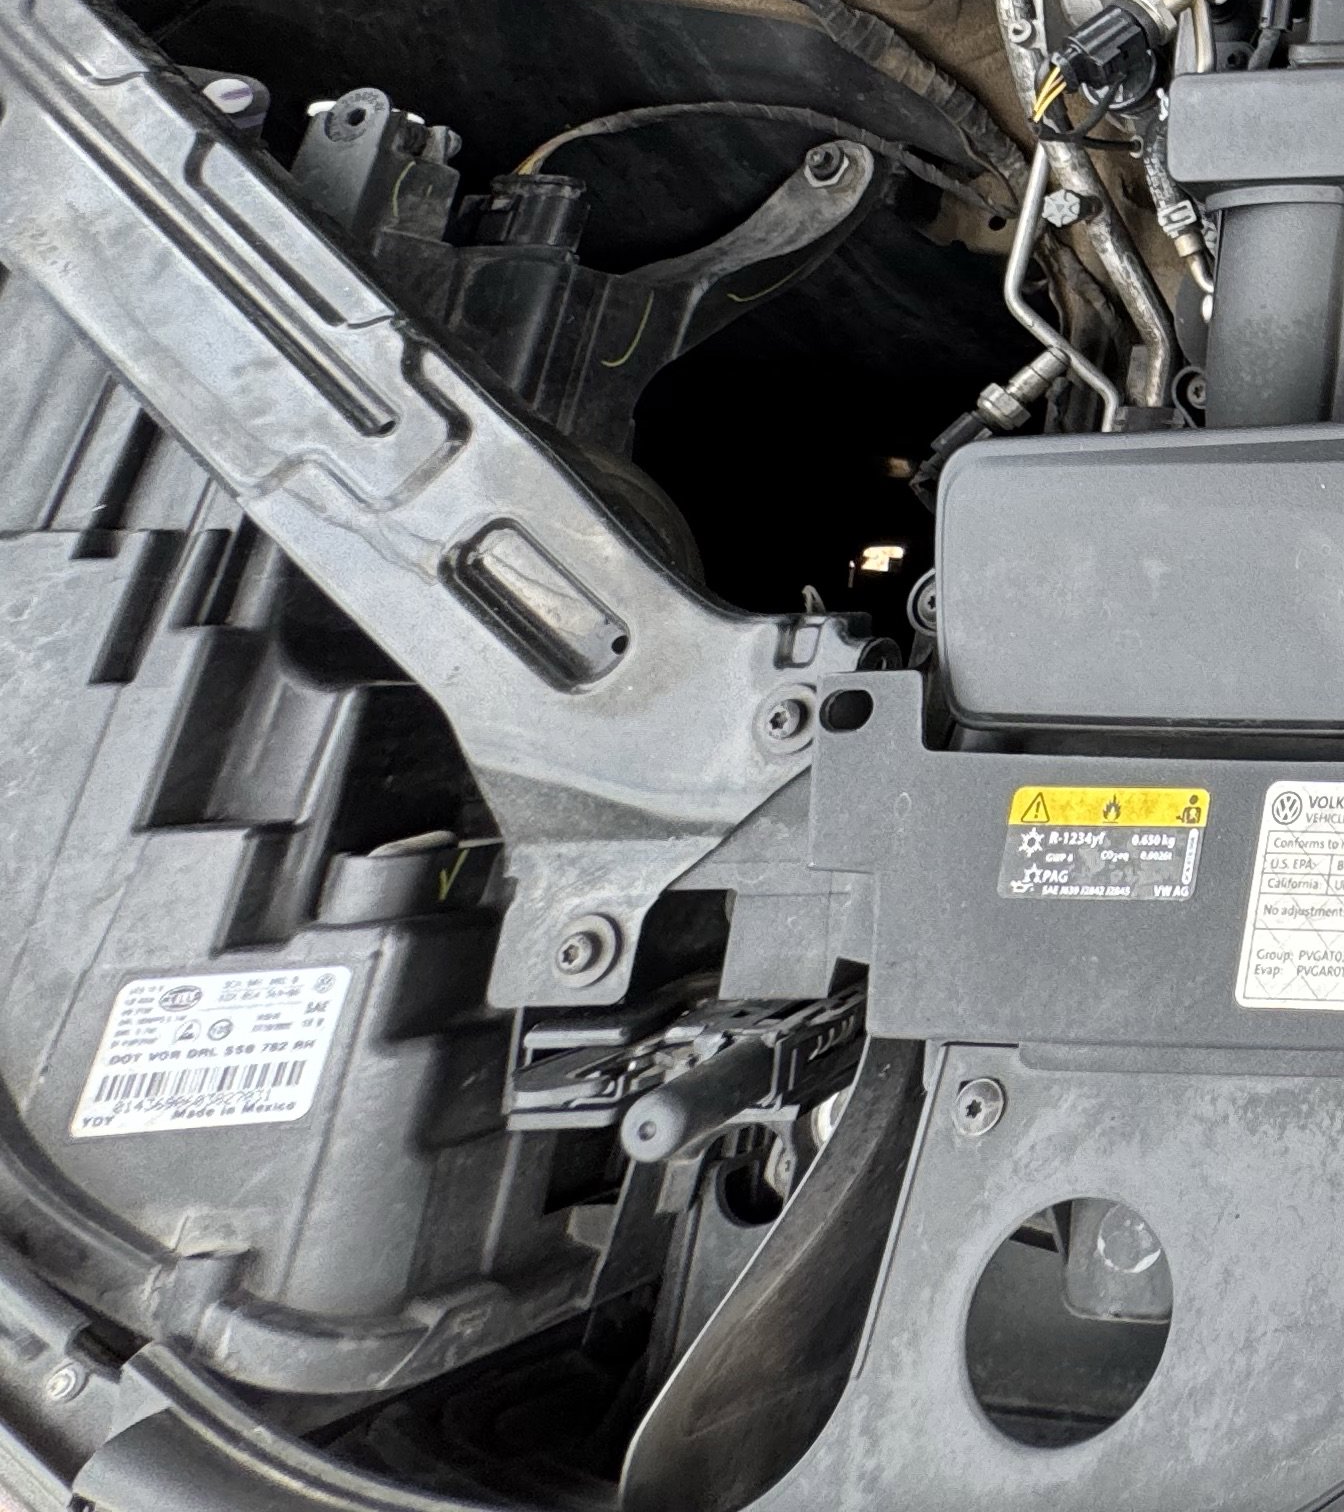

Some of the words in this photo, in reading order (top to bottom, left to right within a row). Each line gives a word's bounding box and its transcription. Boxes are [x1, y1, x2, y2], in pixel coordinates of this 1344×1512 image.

[1049, 831, 1105, 848] R-1234yf
[1273, 837, 1325, 849] Conforms
[1328, 838, 1339, 849] to
[1042, 869, 1069, 883] PAG
[1154, 885, 1175, 897] VW
[1175, 885, 1190, 897] AG
[1264, 905, 1278, 915] No
[109, 1052, 142, 1065] DOT
[149, 1049, 181, 1061] VOR
[186, 1047, 218, 1059] DRL
[171, 1107, 215, 1120] Made
[221, 1104, 235, 1116] in
[241, 1101, 296, 1115] Mexico
